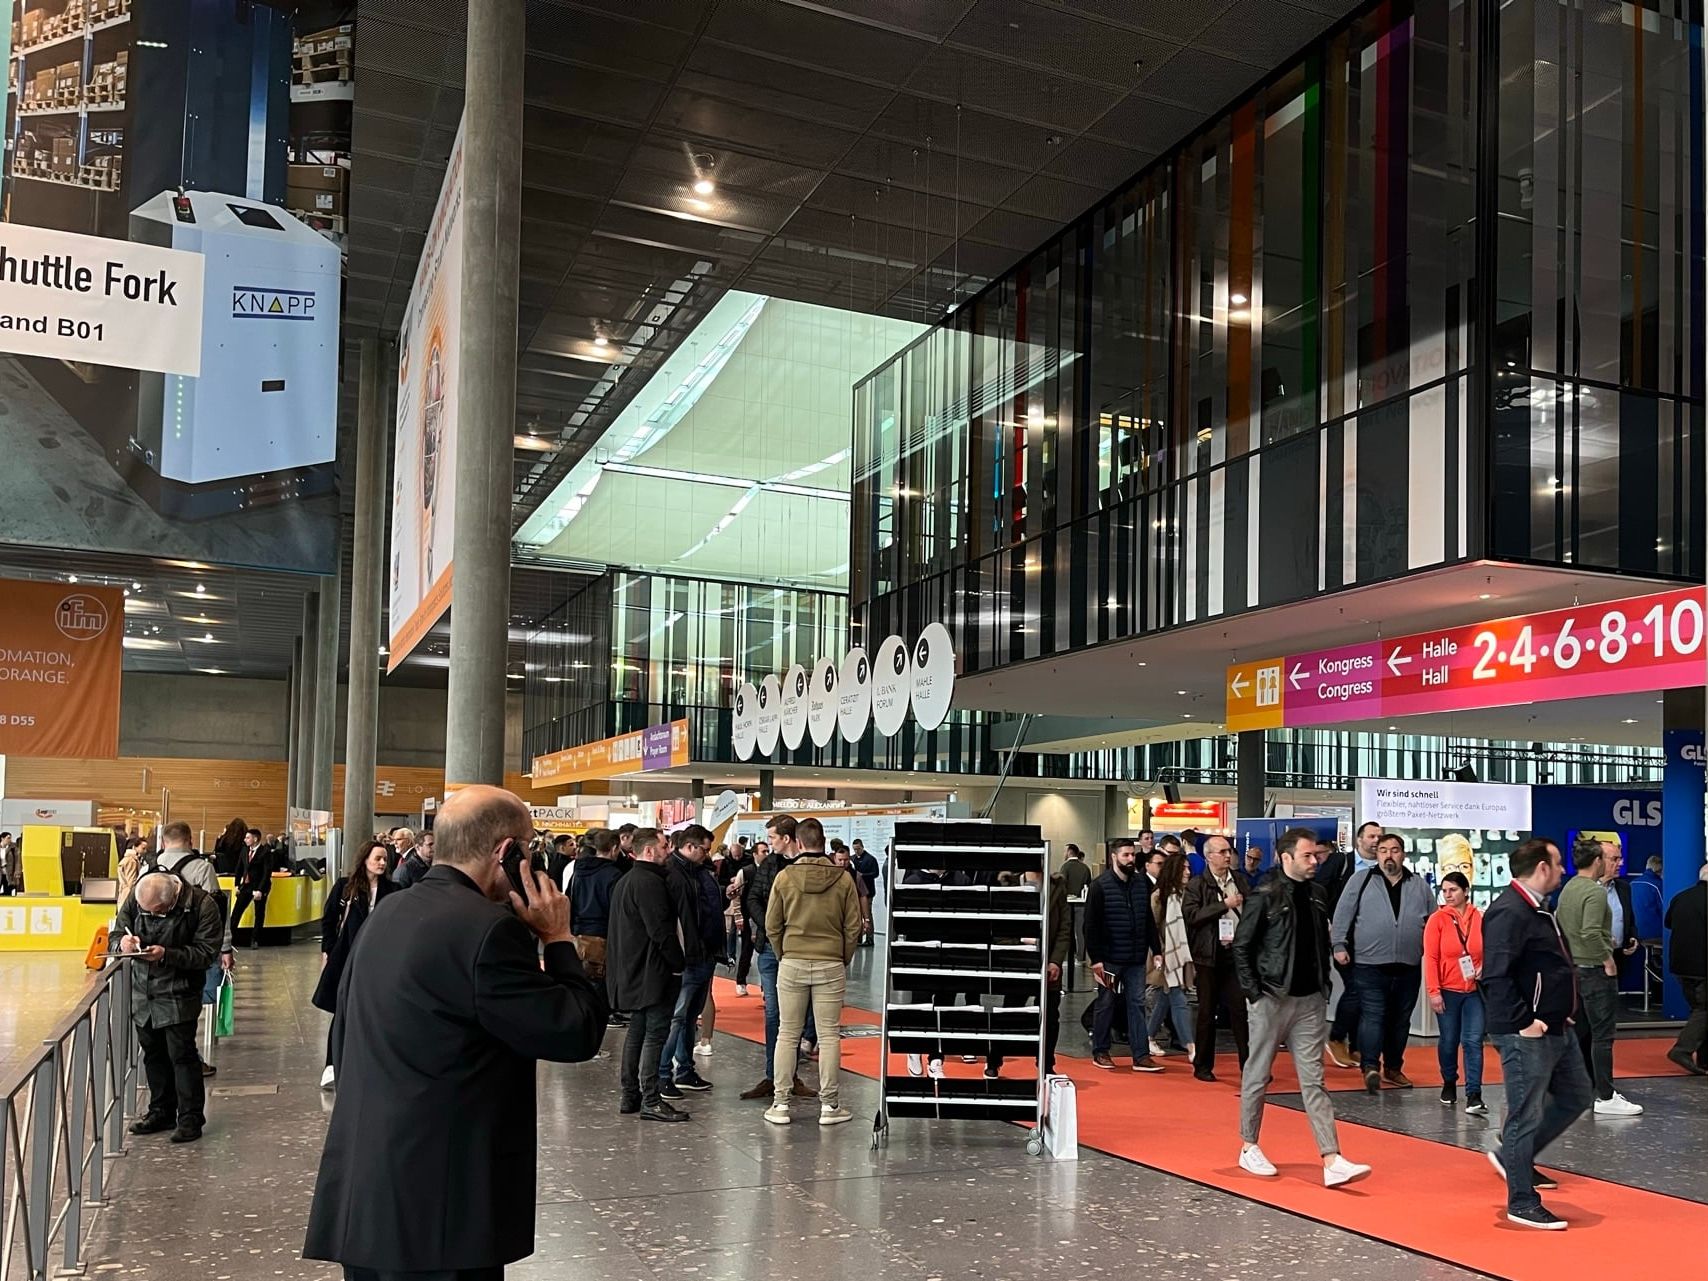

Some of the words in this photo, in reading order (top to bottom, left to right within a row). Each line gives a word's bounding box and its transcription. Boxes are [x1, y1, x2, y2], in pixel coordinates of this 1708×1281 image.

[104, 261, 178, 306] Fork
[232, 292, 316, 314] KNAPP
[57, 318, 104, 342] B01
[60, 599, 102, 630] ifm
[1422, 637, 1458, 659] Halle
[0, 667, 70, 685] ORANGE.
[1318, 655, 1373, 676] Kongress
[1422, 665, 1449, 686] Hall
[916, 675, 933, 688] MAHLE
[1318, 680, 1373, 701] Congress
[876, 697, 894, 710] FORUM
[915, 688, 931, 700] HALLE
[10, 714, 36, 727] D55
[1376, 788, 1391, 798] Wir
[1392, 789, 1409, 799] sind
[1411, 790, 1439, 799] schnell
[1376, 800, 1406, 809] Flexibler,
[1408, 801, 1439, 810] nahtloser
[1440, 802, 1463, 810] Service
[1481, 803, 1507, 812] Europas
[1408, 810, 1459, 819] Paket-Netzwerk
[1612, 799, 1662, 827] GLS
